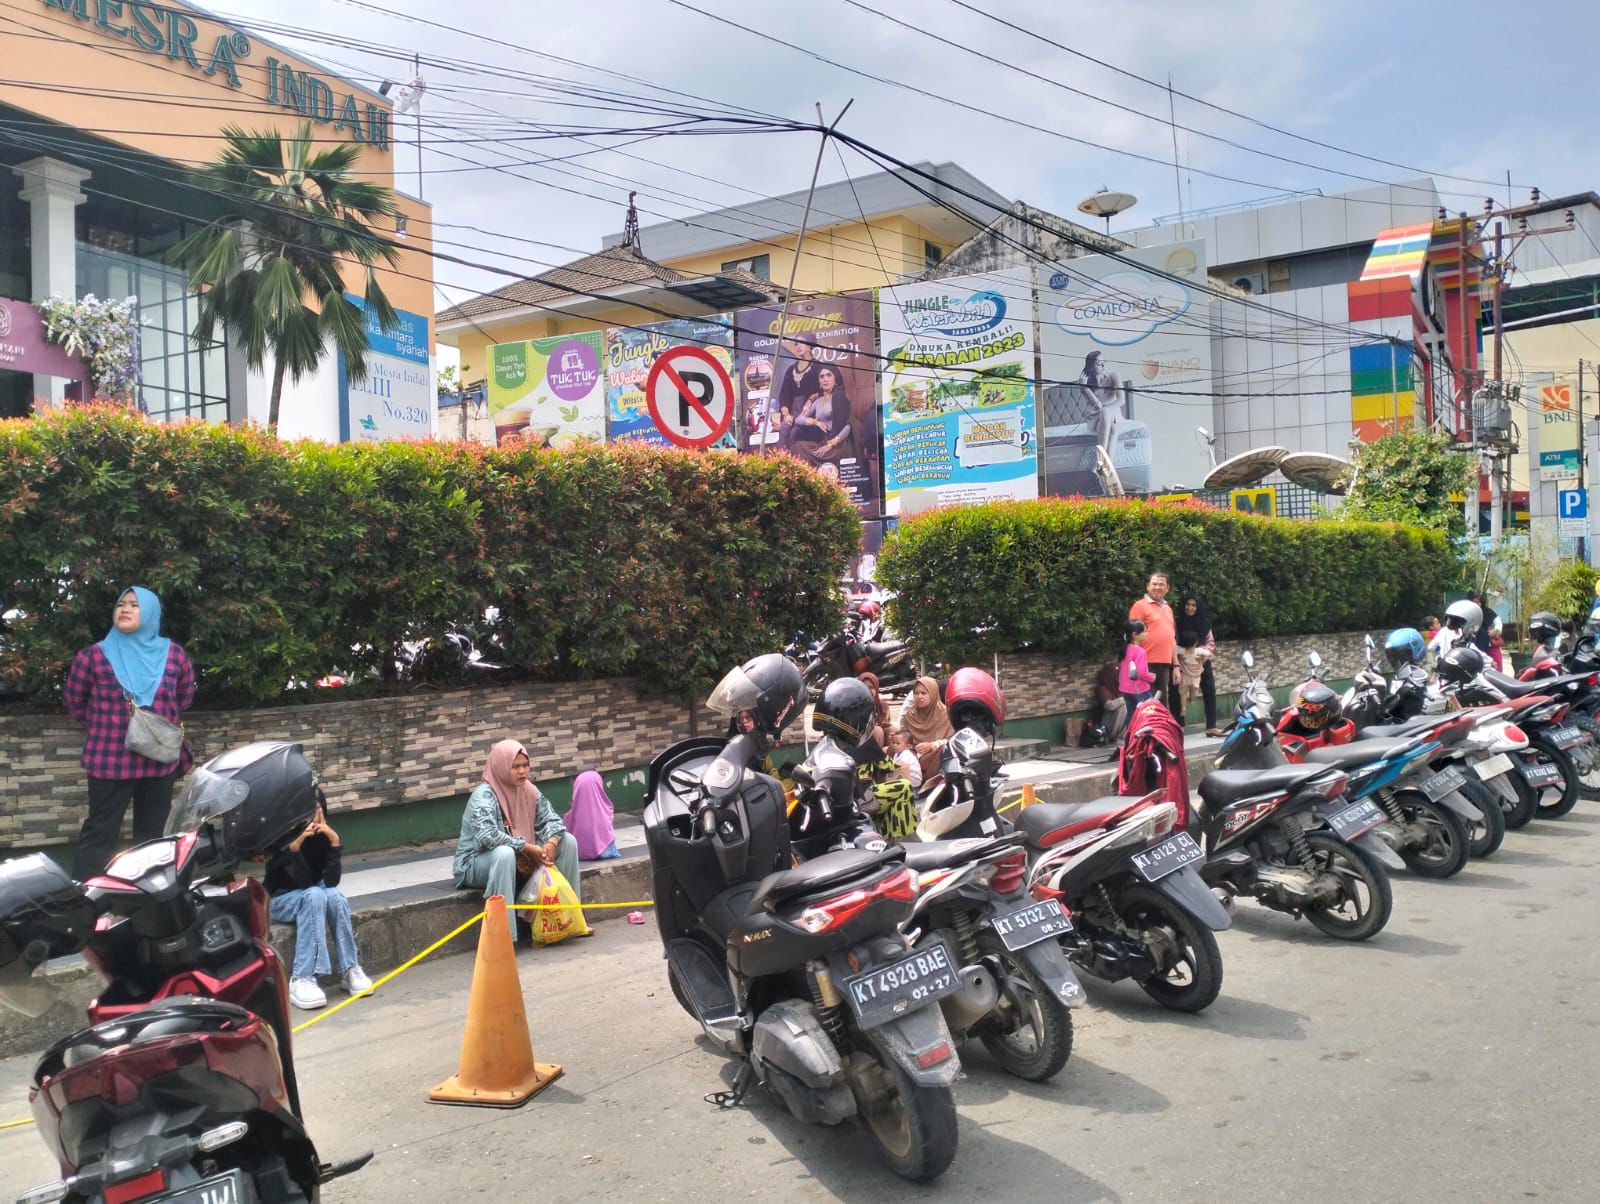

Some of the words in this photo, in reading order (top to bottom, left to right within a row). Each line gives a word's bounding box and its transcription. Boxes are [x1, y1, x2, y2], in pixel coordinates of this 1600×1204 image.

[267, 56, 389, 152] INDAH
[903, 295, 949, 314] JUNGLE
[1074, 298, 1160, 320] COMFORTA
[769, 312, 843, 337] Summer
[816, 327, 860, 339] EXHIBITION
[609, 333, 669, 367] Jungle
[812, 342, 860, 363] 2024
[904, 347, 981, 367] LEBARAN
[982, 332, 1026, 358] 2023
[909, 343, 952, 352] DIBUKA
[374, 362, 401, 381] Mesra
[403, 370, 428, 388] Indah
[551, 373, 573, 385] TUK
[574, 369, 597, 381] TUK
[383, 401, 428, 425] No.320
[1544, 411, 1572, 424] BNI
[1565, 491, 1581, 515] P
[1134, 853, 1151, 868] KT
[1152, 842, 1177, 860] 6129
[1178, 835, 1194, 848] CL
[996, 919, 1014, 935] KT
[1015, 907, 1046, 928] 5732
[854, 980, 876, 1003] KT
[880, 963, 918, 992] 4928
[917, 949, 946, 976] BAE
